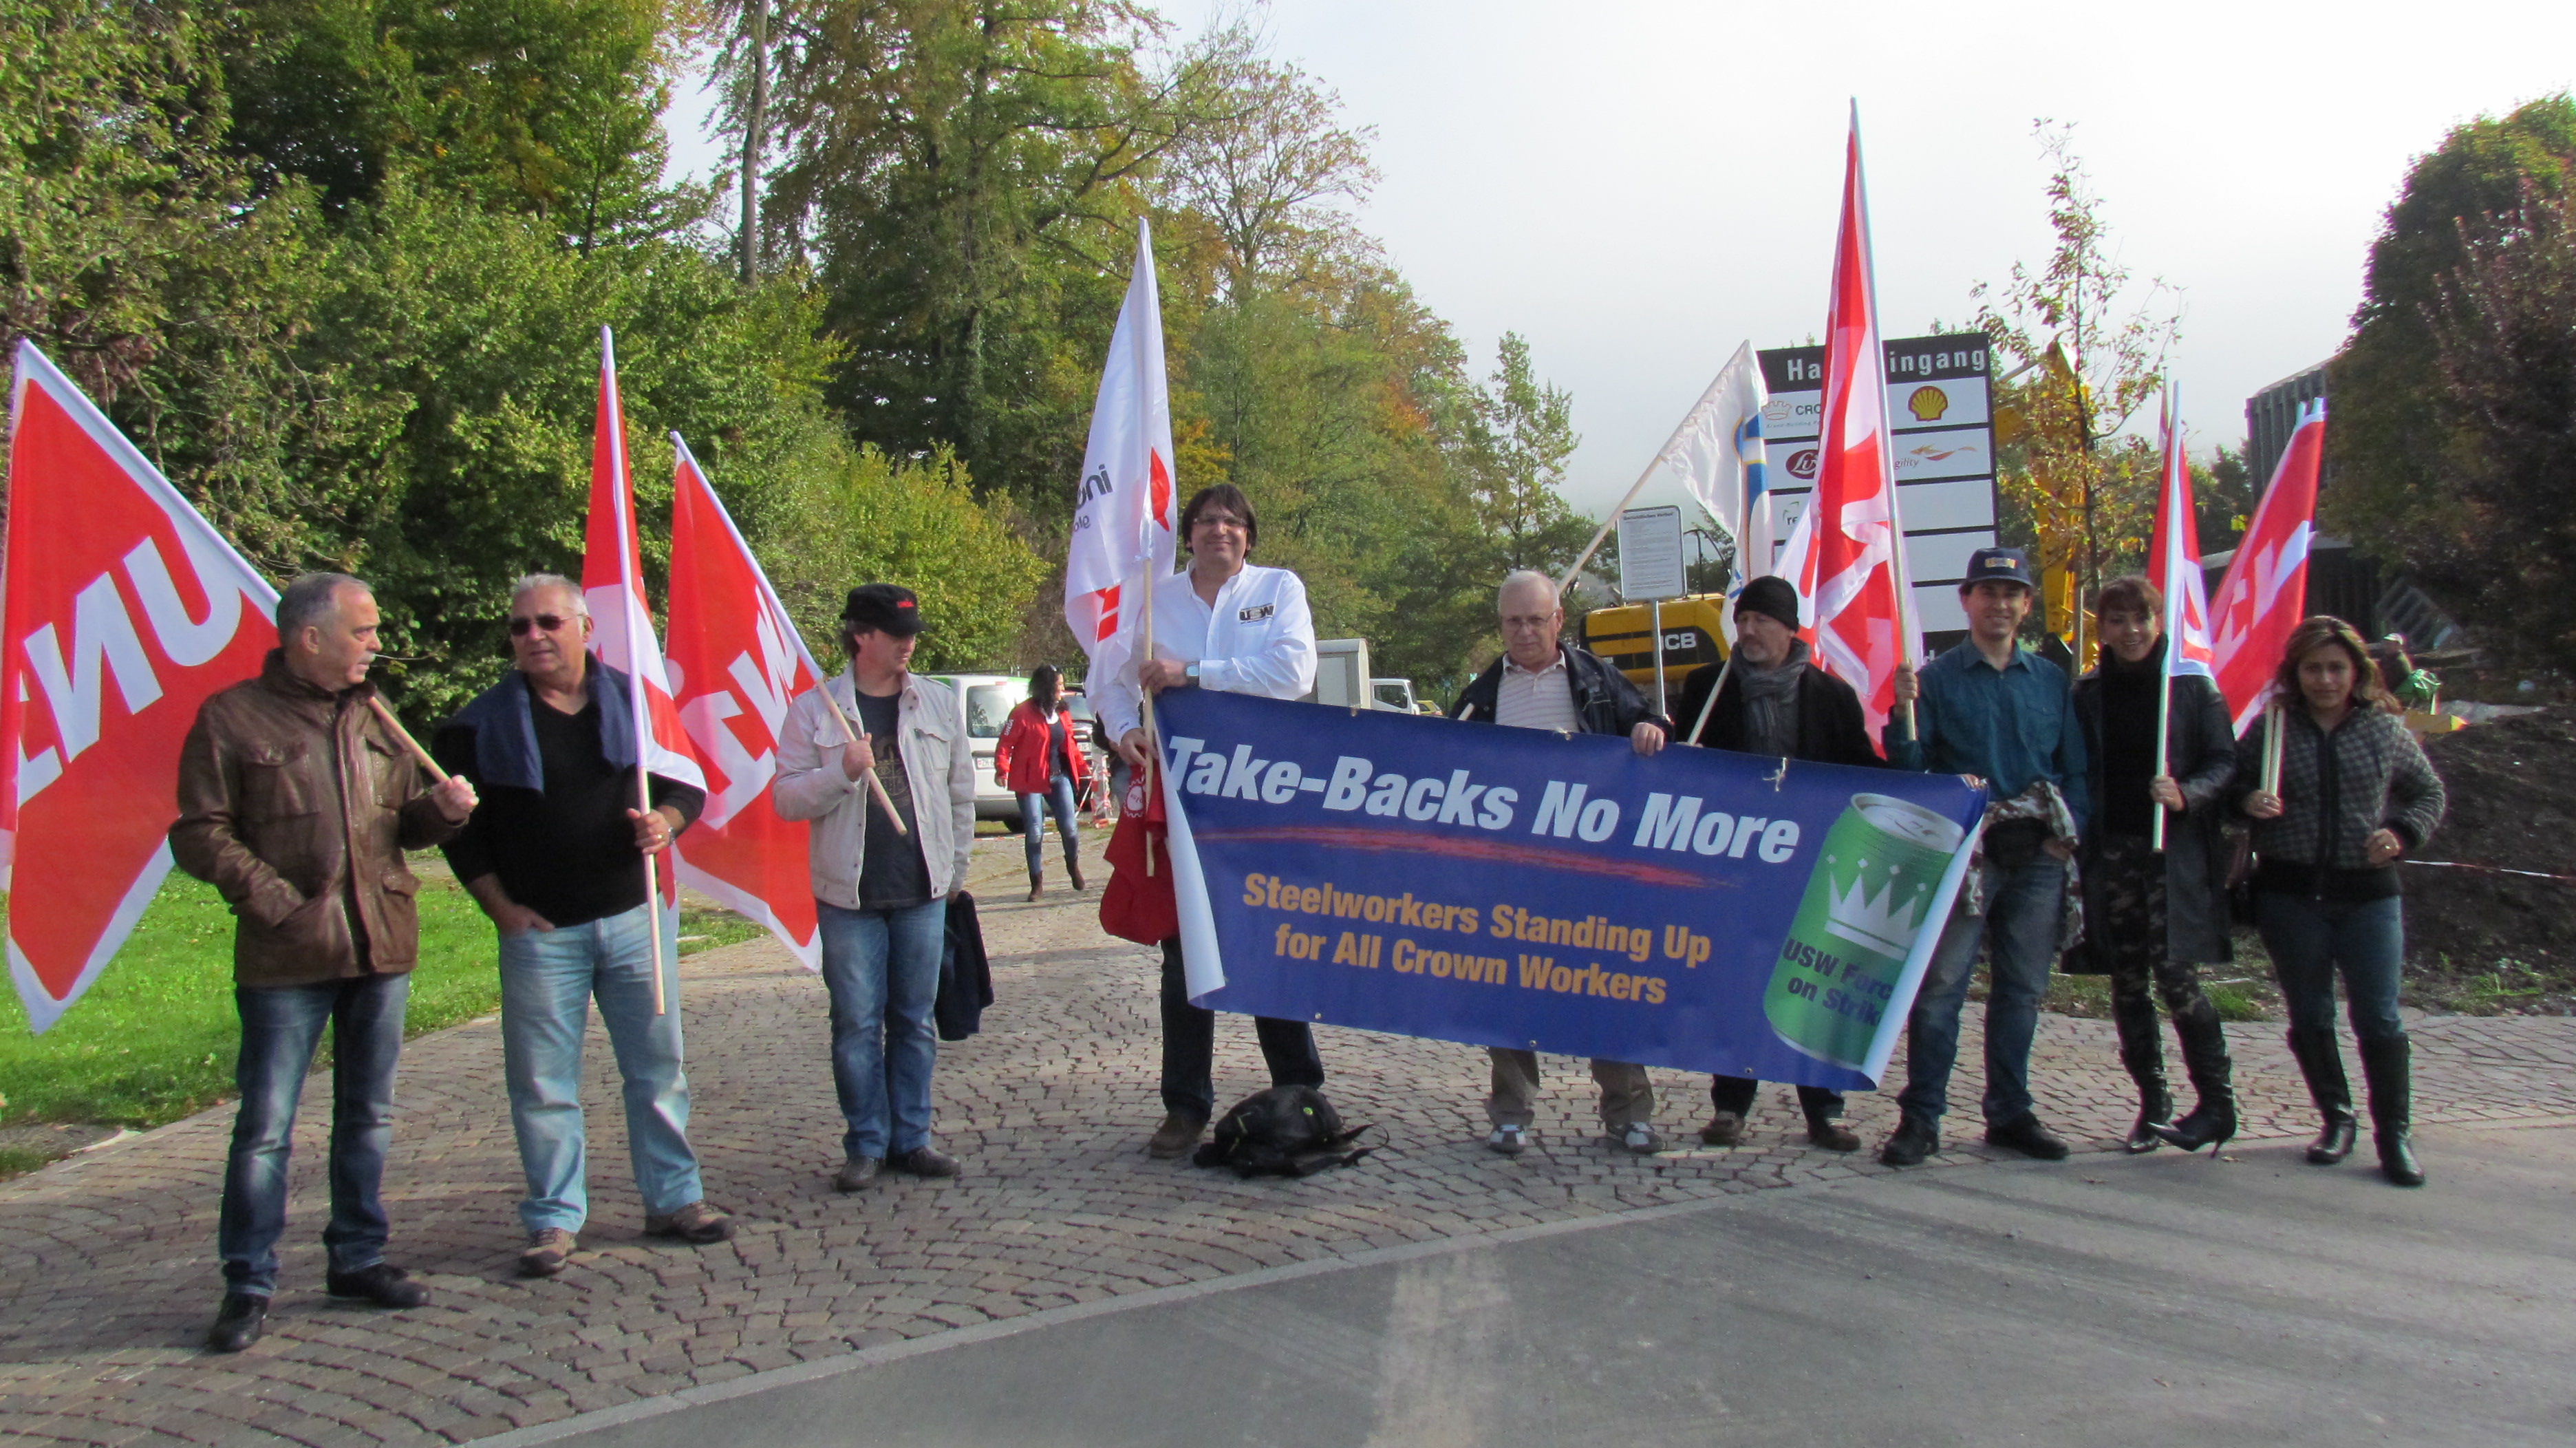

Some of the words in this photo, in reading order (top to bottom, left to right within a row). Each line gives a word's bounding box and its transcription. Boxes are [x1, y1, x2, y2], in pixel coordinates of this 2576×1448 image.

[1894, 458, 1919, 470] gility
[1168, 735, 1518, 830] Take-Backs
[1532, 780, 1620, 842] No
[1632, 791, 1800, 863] More
[1243, 873, 1479, 934] Steelworkers
[1490, 904, 1652, 962] Standing
[1662, 924, 1711, 968] Up
[1274, 923, 1327, 961] for
[1333, 933, 1381, 969] All
[1391, 938, 1508, 985] Crown
[1518, 954, 1667, 1004] Workers
[1782, 938, 1840, 977] USW
[1839, 963, 1893, 1000] Forc
[1788, 977, 1818, 1002] on
[1822, 987, 1882, 1027] Strik
